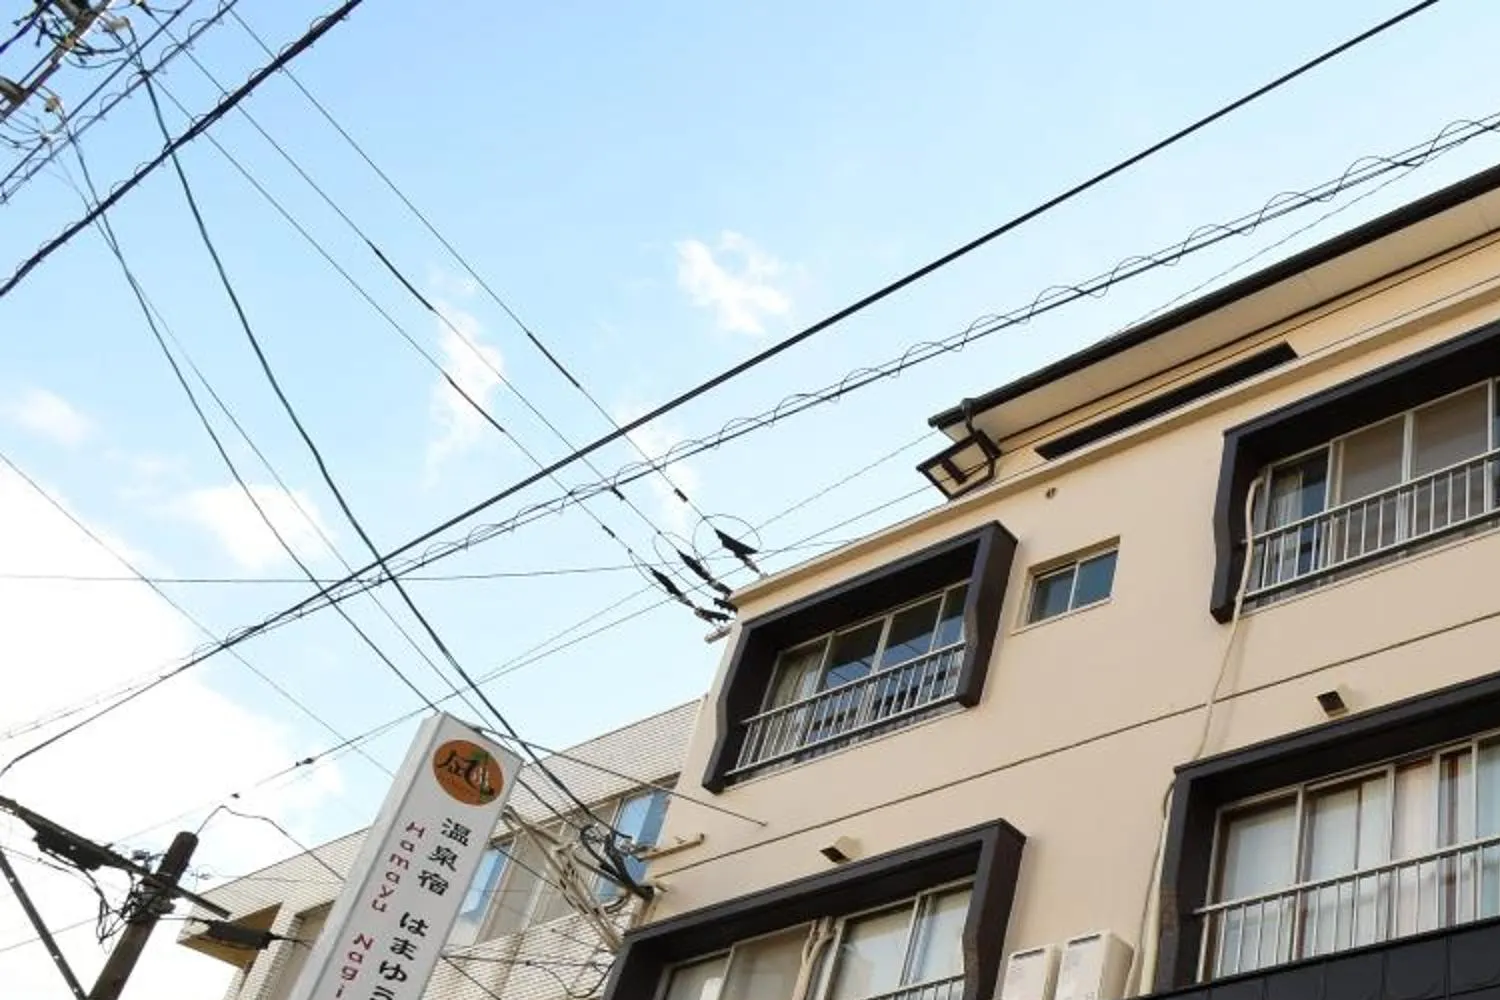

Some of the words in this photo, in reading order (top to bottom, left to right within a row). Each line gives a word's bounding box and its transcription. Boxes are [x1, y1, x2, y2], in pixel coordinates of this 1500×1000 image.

[371, 821, 426, 914] Hamayu
[418, 817, 473, 896] 温泉宿
[336, 933, 375, 999] Nagi
